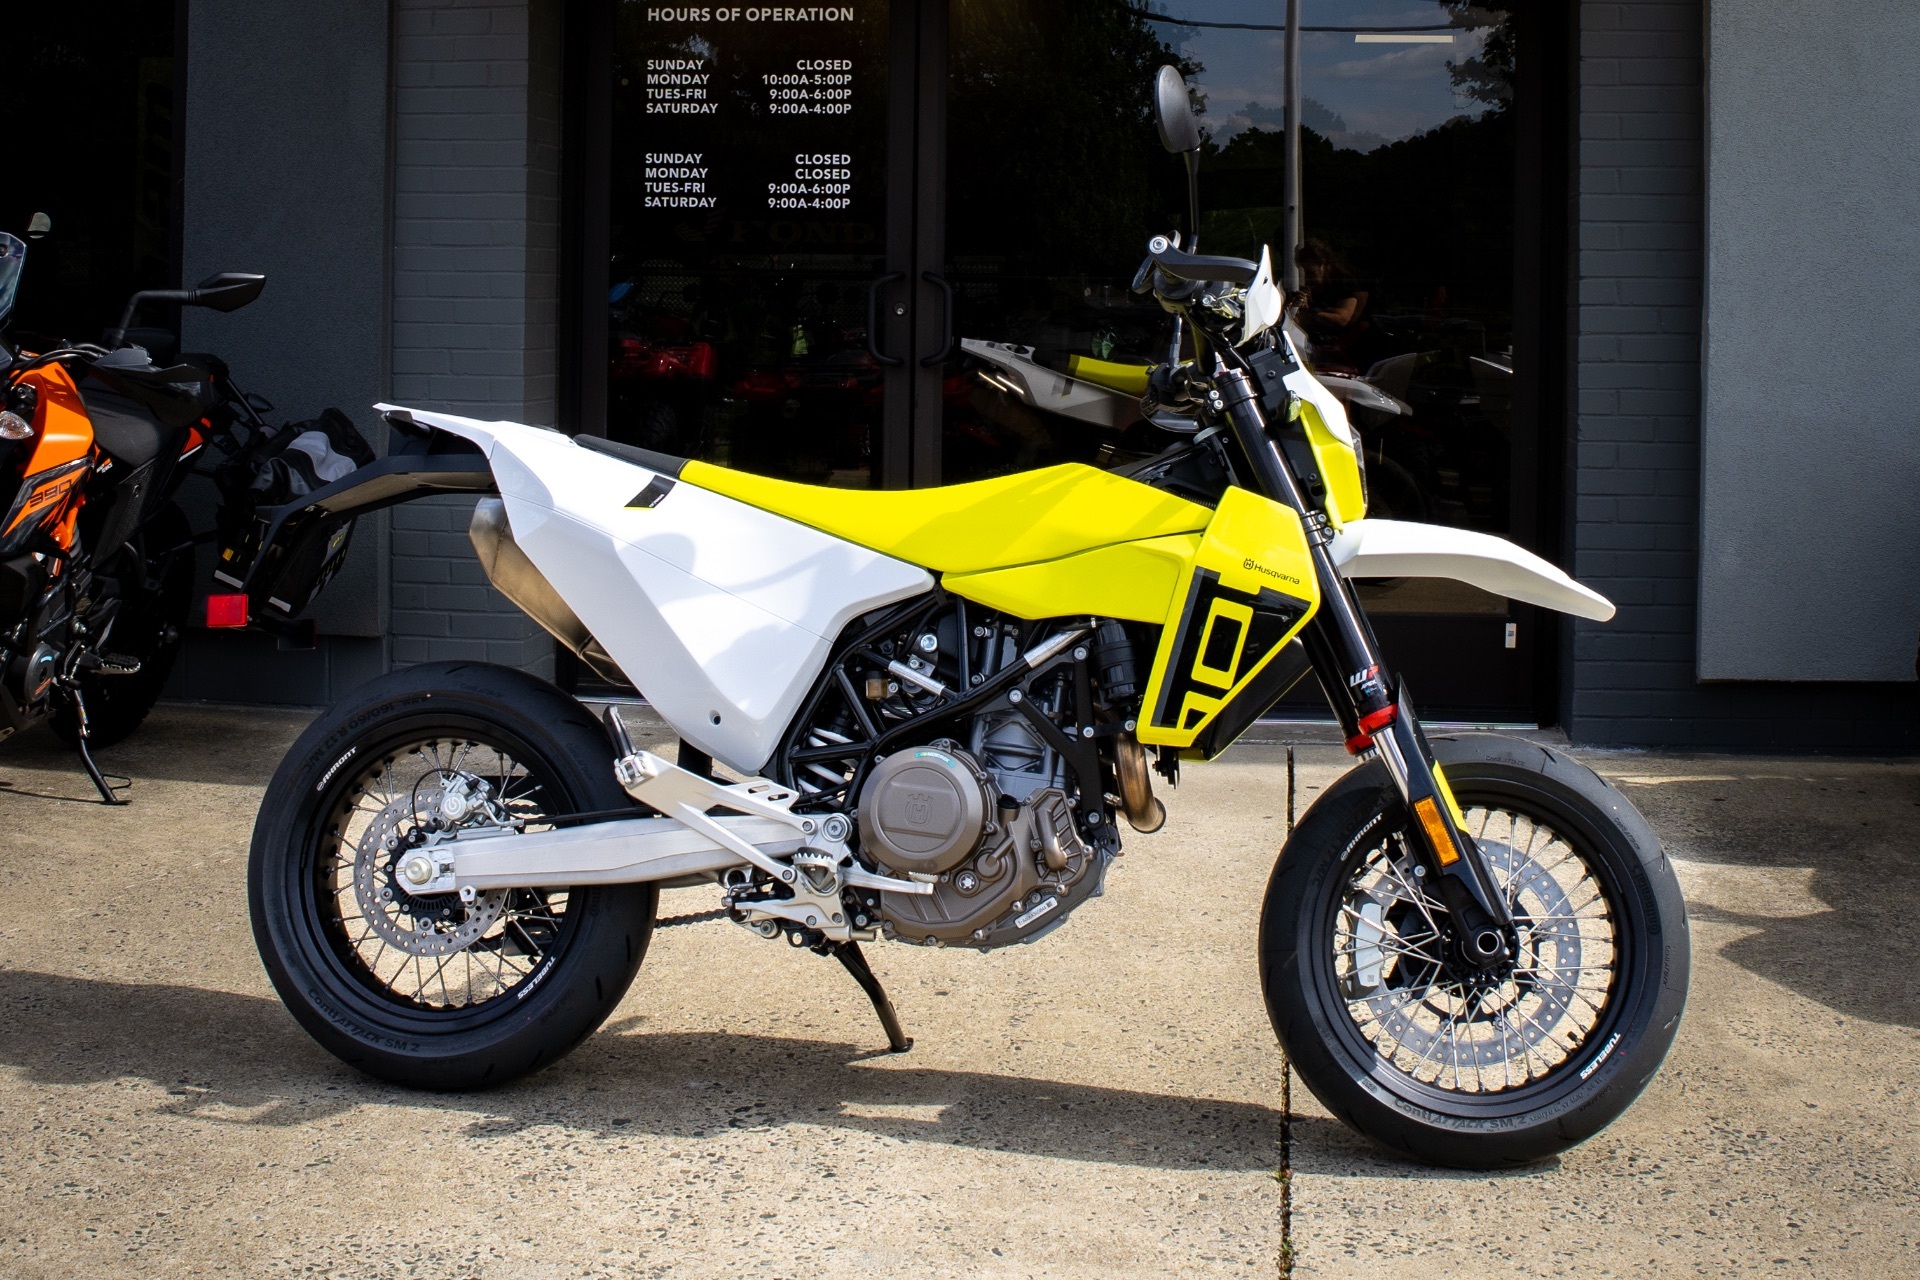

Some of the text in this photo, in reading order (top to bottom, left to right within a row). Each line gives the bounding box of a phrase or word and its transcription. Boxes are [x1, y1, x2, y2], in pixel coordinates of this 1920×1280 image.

[647, 7, 854, 22] HOURS OF OPERATION
[647, 60, 852, 71] SUNDAY CLOSED
[647, 74, 852, 85] MONDAY 10:00A-5:00P
[646, 89, 852, 100] TUES-FRI 9:00A-6:00P
[646, 103, 852, 114] SATURDAY 9:00A-4:00P
[645, 153, 851, 165] SUNDAY CLOSED
[645, 168, 851, 180] MONDAY CLOSED
[645, 182, 851, 194] TUES-FRI 9:00A-6:00P
[644, 197, 851, 209] SATURDAY 9:00A-4:00P
[30, 479, 72, 508] 390
[1254, 563, 1300, 585] Husqvarna
[517, 956, 557, 1000] TUBELESS
[385, 1039, 407, 1051] SM
[410, 1042, 420, 1052] 2
[1580, 1032, 1621, 1080] TUBELESS
[1489, 1118, 1513, 1129] SM
[1517, 1115, 1527, 1125] 2
